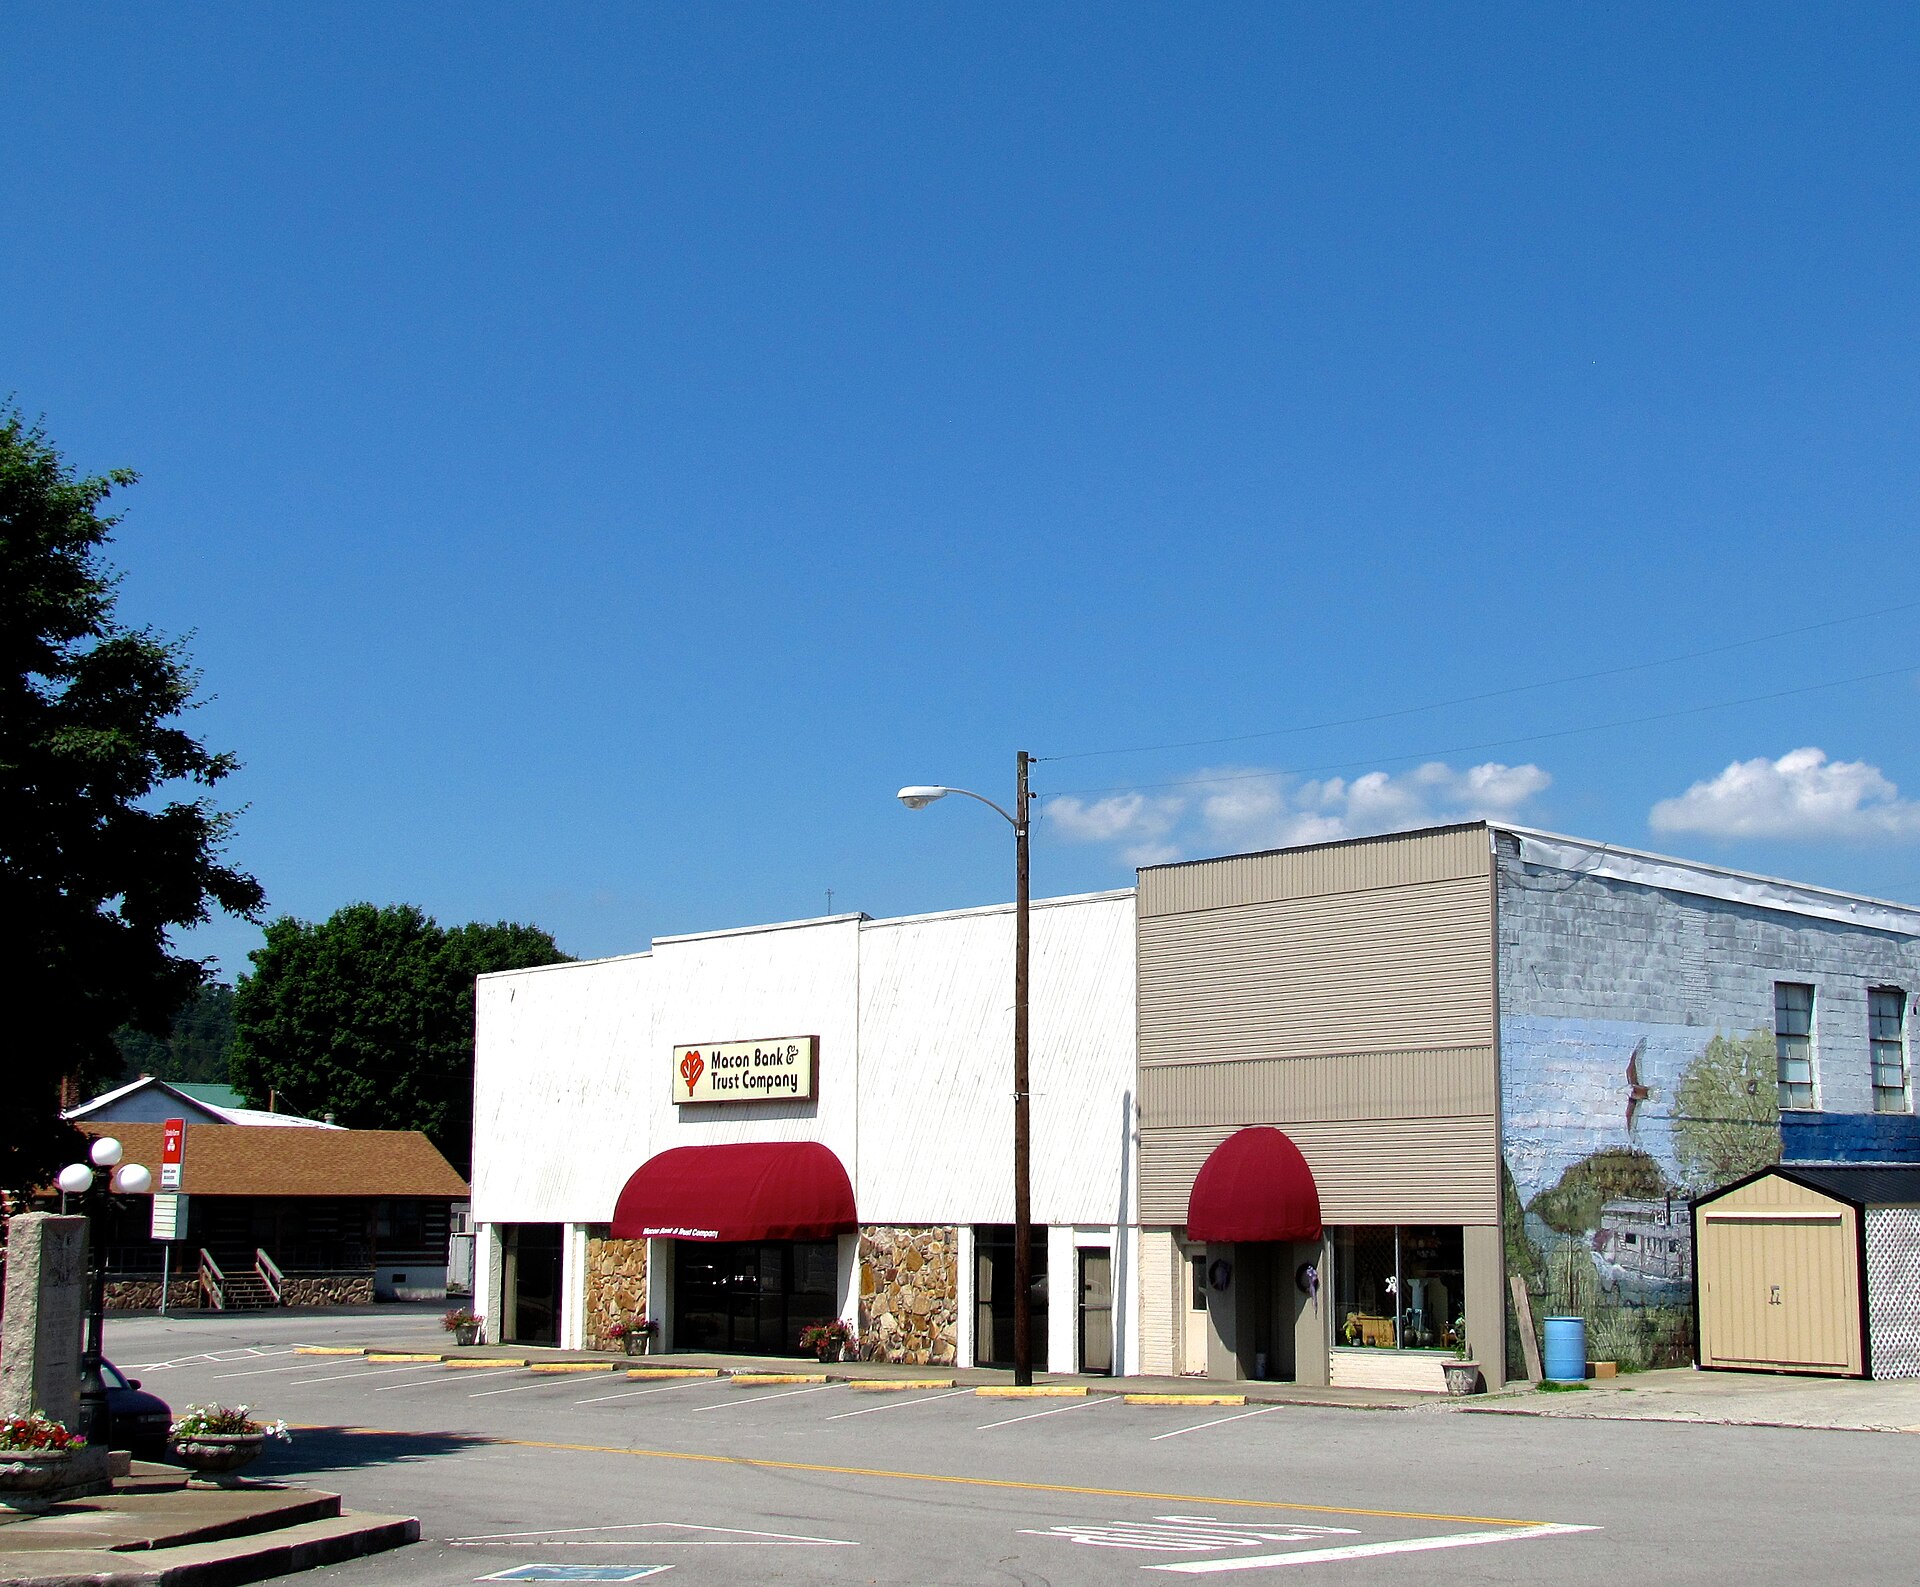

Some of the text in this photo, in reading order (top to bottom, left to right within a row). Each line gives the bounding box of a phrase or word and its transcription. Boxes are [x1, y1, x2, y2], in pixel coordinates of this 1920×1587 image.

[711, 1045, 799, 1069] Macon Bank &
[711, 1070, 798, 1093] Trust Company
[692, 1228, 719, 1239] Company
